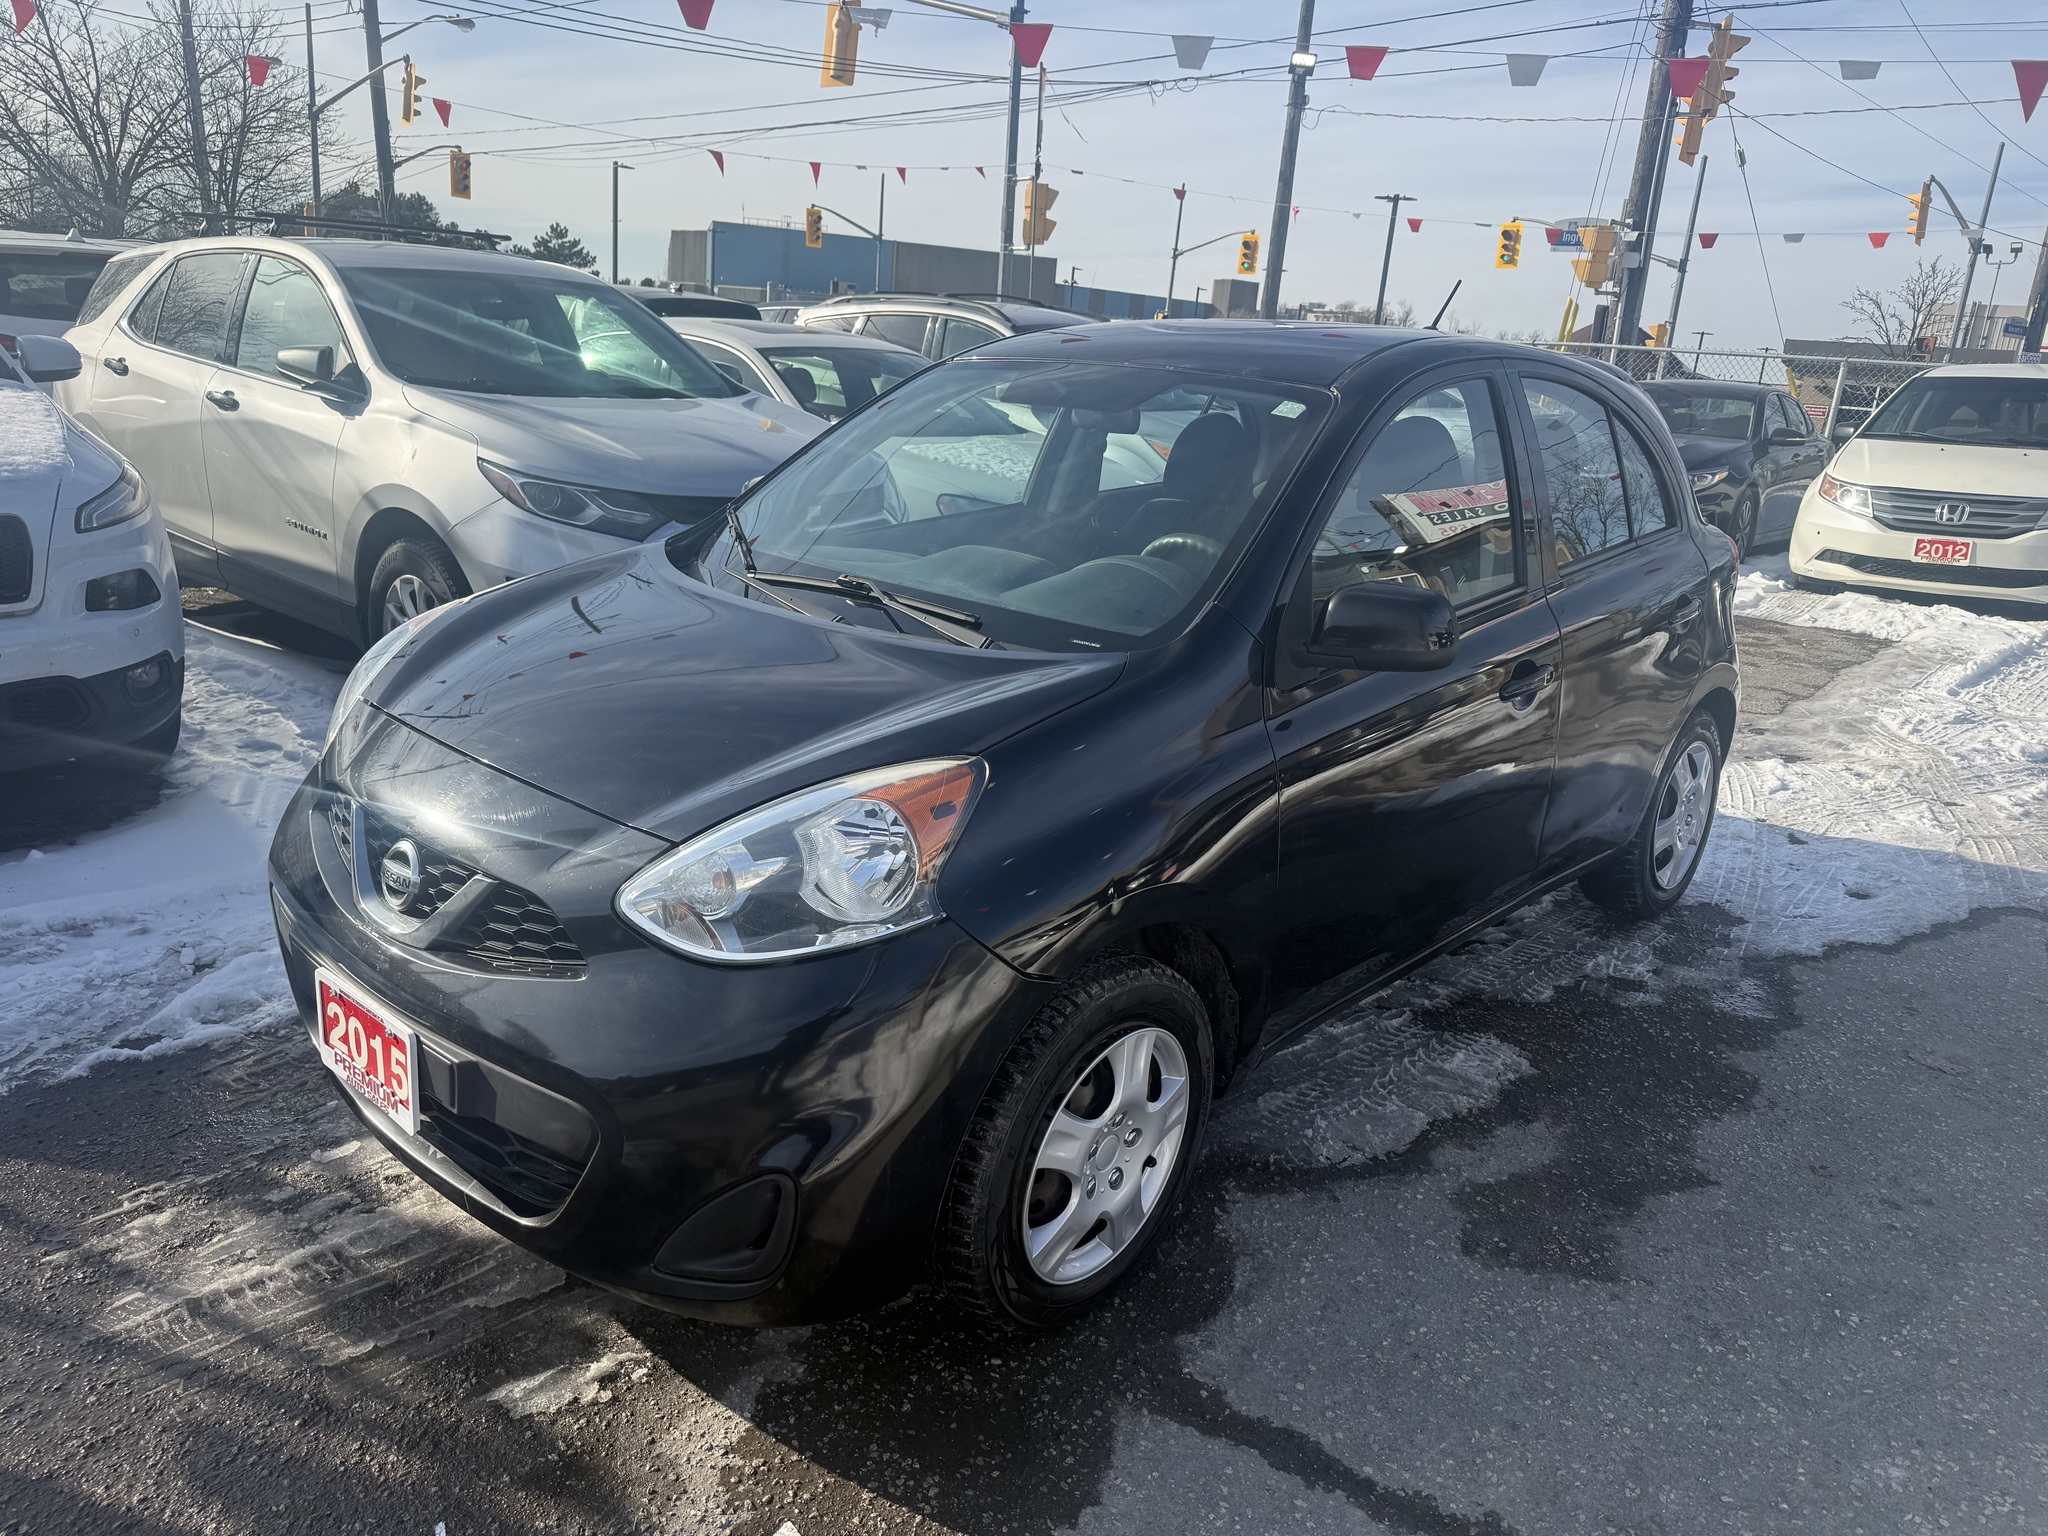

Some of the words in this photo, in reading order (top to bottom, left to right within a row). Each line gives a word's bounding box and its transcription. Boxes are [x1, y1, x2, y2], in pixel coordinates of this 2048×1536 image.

[1562, 231, 1582, 244] Ingr
[1916, 542, 1967, 560] 2012
[382, 867, 411, 890] SSAN
[326, 1001, 409, 1101] 2015
[333, 1048, 401, 1115] PREMIUM
[345, 1074, 367, 1099] AUTO
[366, 1089, 390, 1116] SALES
